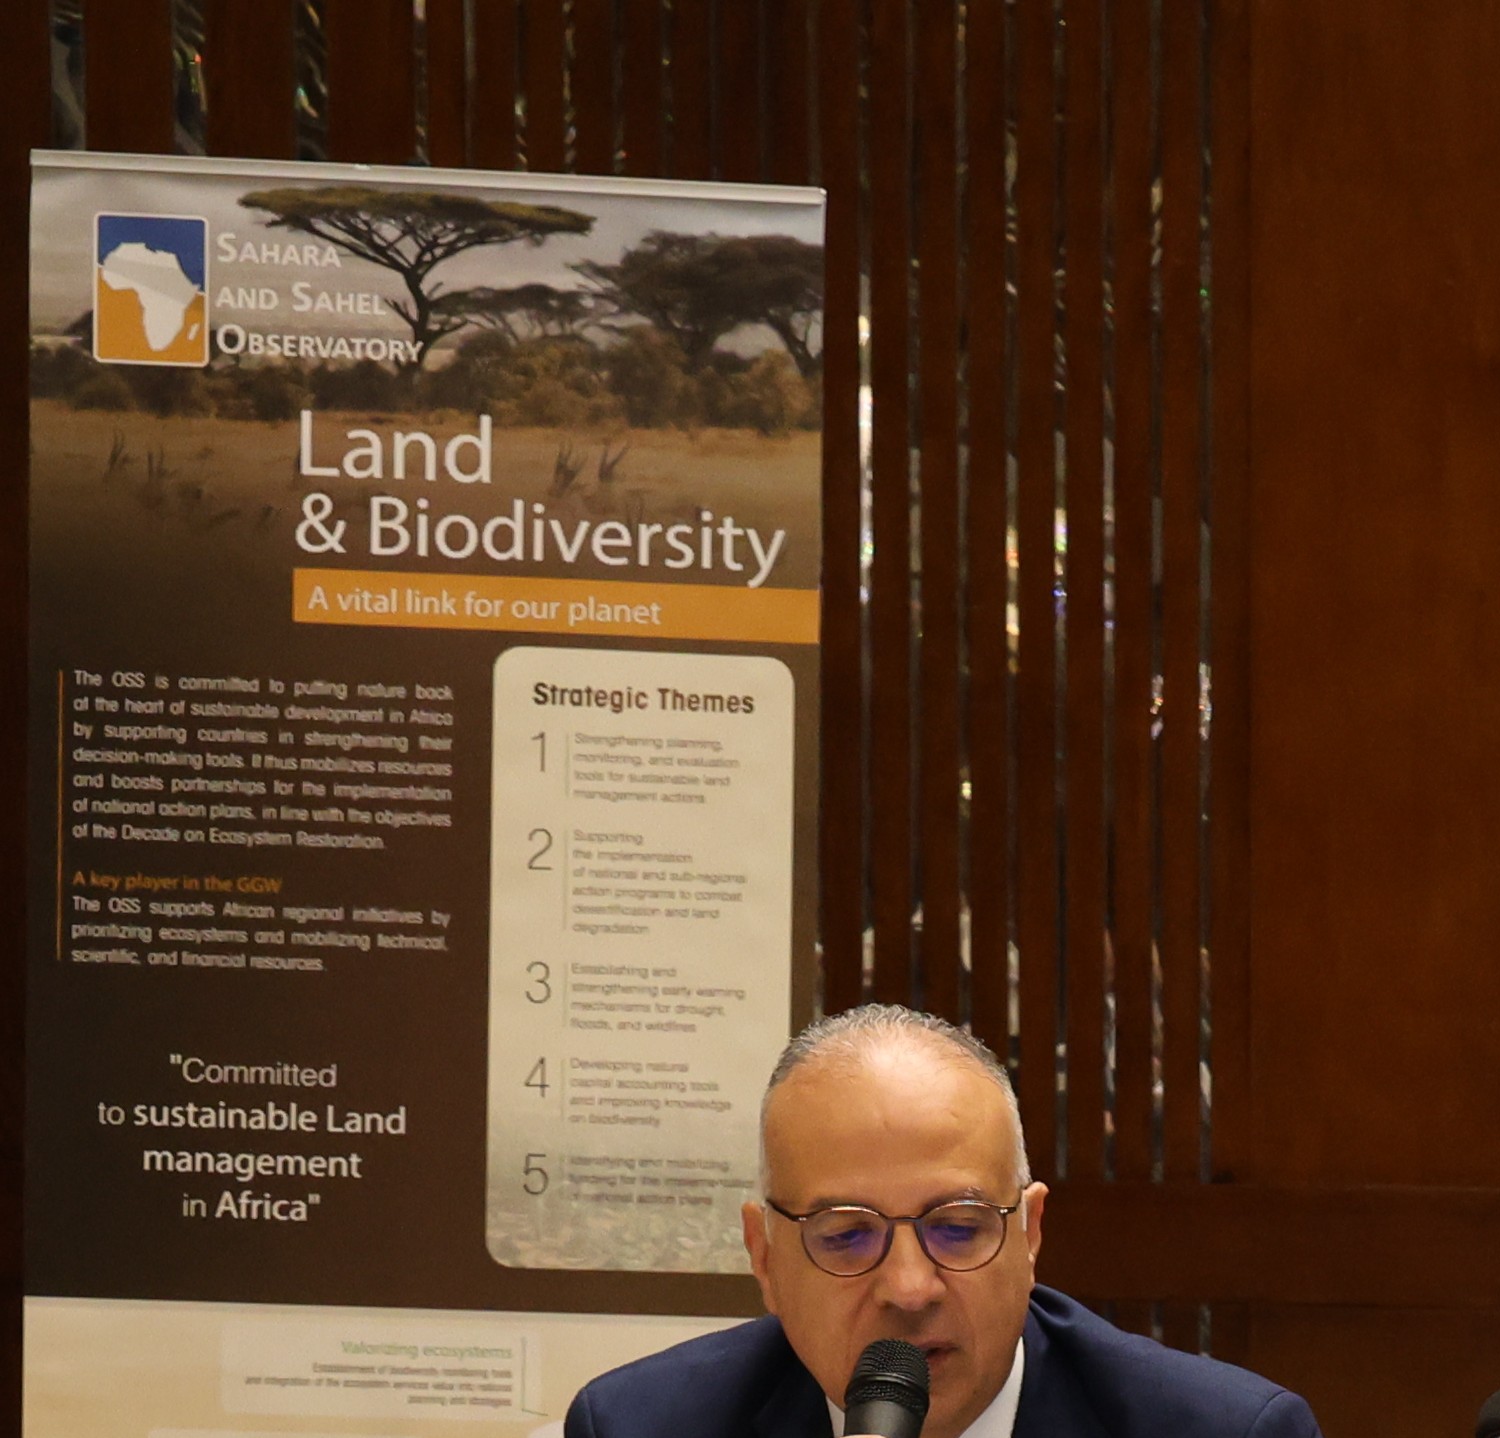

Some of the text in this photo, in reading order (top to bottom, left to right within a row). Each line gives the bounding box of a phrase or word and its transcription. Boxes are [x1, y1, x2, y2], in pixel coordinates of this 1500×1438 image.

[300, 410, 492, 483] Land
[296, 493, 784, 587] & Biodiversity
[308, 586, 661, 626] A vital link for our planet
[533, 682, 754, 714] Strategic Themes
[531, 731, 546, 772] 1
[527, 828, 553, 871] 2
[525, 961, 551, 1004] 3
[170, 1054, 337, 1087] "Committed
[524, 1057, 550, 1098] 4
[98, 1101, 406, 1134] to sustainable Land
[144, 1150, 362, 1182] management
[522, 1153, 549, 1197] 5
[183, 1190, 320, 1221] in Africa"
